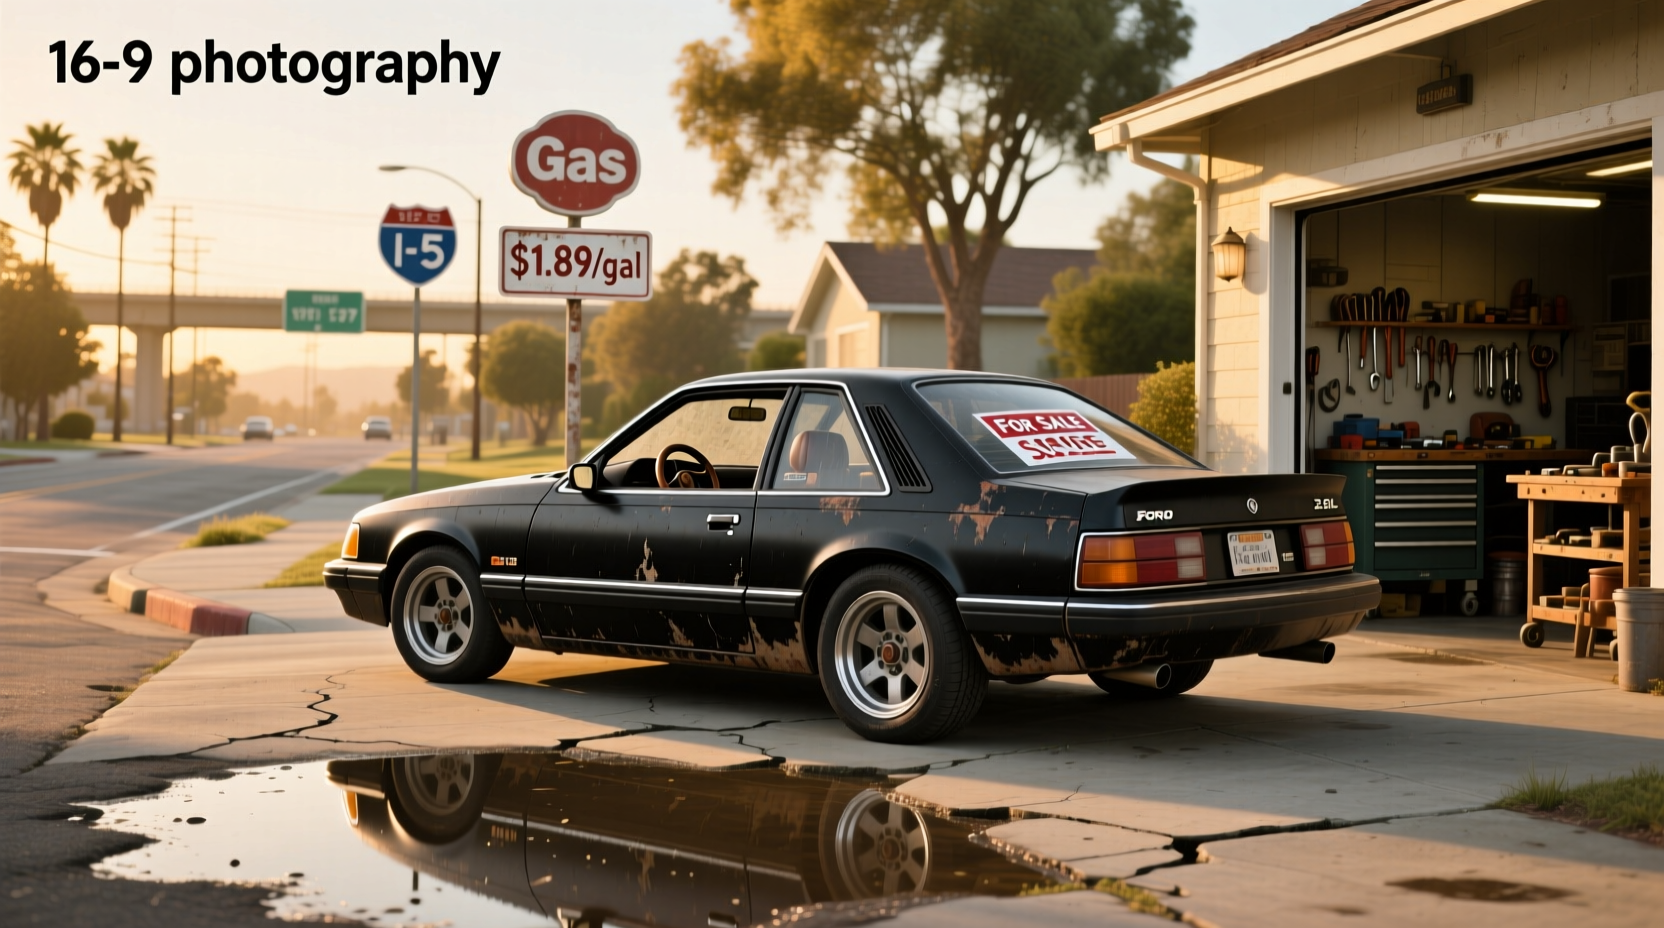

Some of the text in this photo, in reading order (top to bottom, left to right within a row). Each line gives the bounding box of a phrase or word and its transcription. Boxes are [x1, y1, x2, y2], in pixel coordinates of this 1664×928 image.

[526, 135, 627, 185] Gas
[394, 232, 445, 270] I-5
[510, 240, 641, 286] $1.89/gal
[993, 415, 1086, 434] FOR SALE
